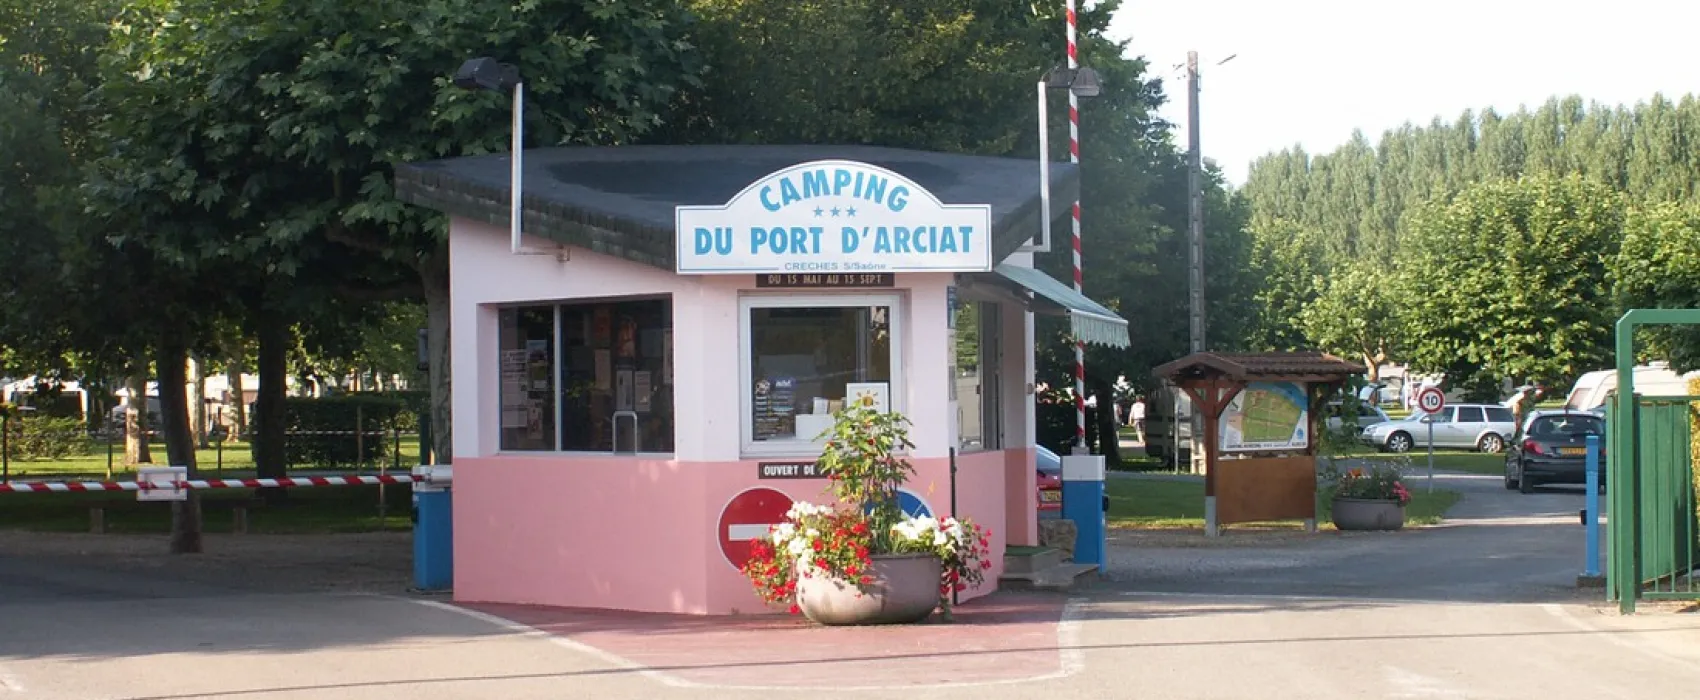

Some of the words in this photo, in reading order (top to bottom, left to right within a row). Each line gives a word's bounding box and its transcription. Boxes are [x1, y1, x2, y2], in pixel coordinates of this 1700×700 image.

[759, 168, 910, 213] CAMPING
[694, 226, 733, 256] DU
[750, 226, 824, 255] PORT
[842, 225, 973, 254] D'ARCIAT
[767, 274, 781, 285] DU
[787, 274, 797, 285] 15
[803, 274, 822, 285] MAI
[826, 274, 839, 285] AU
[844, 274, 855, 285] 15
[860, 274, 882, 285] SEPT
[1425, 395, 1438, 406] 10
[763, 464, 799, 476] OUVERT
[803, 464, 815, 476] DE
